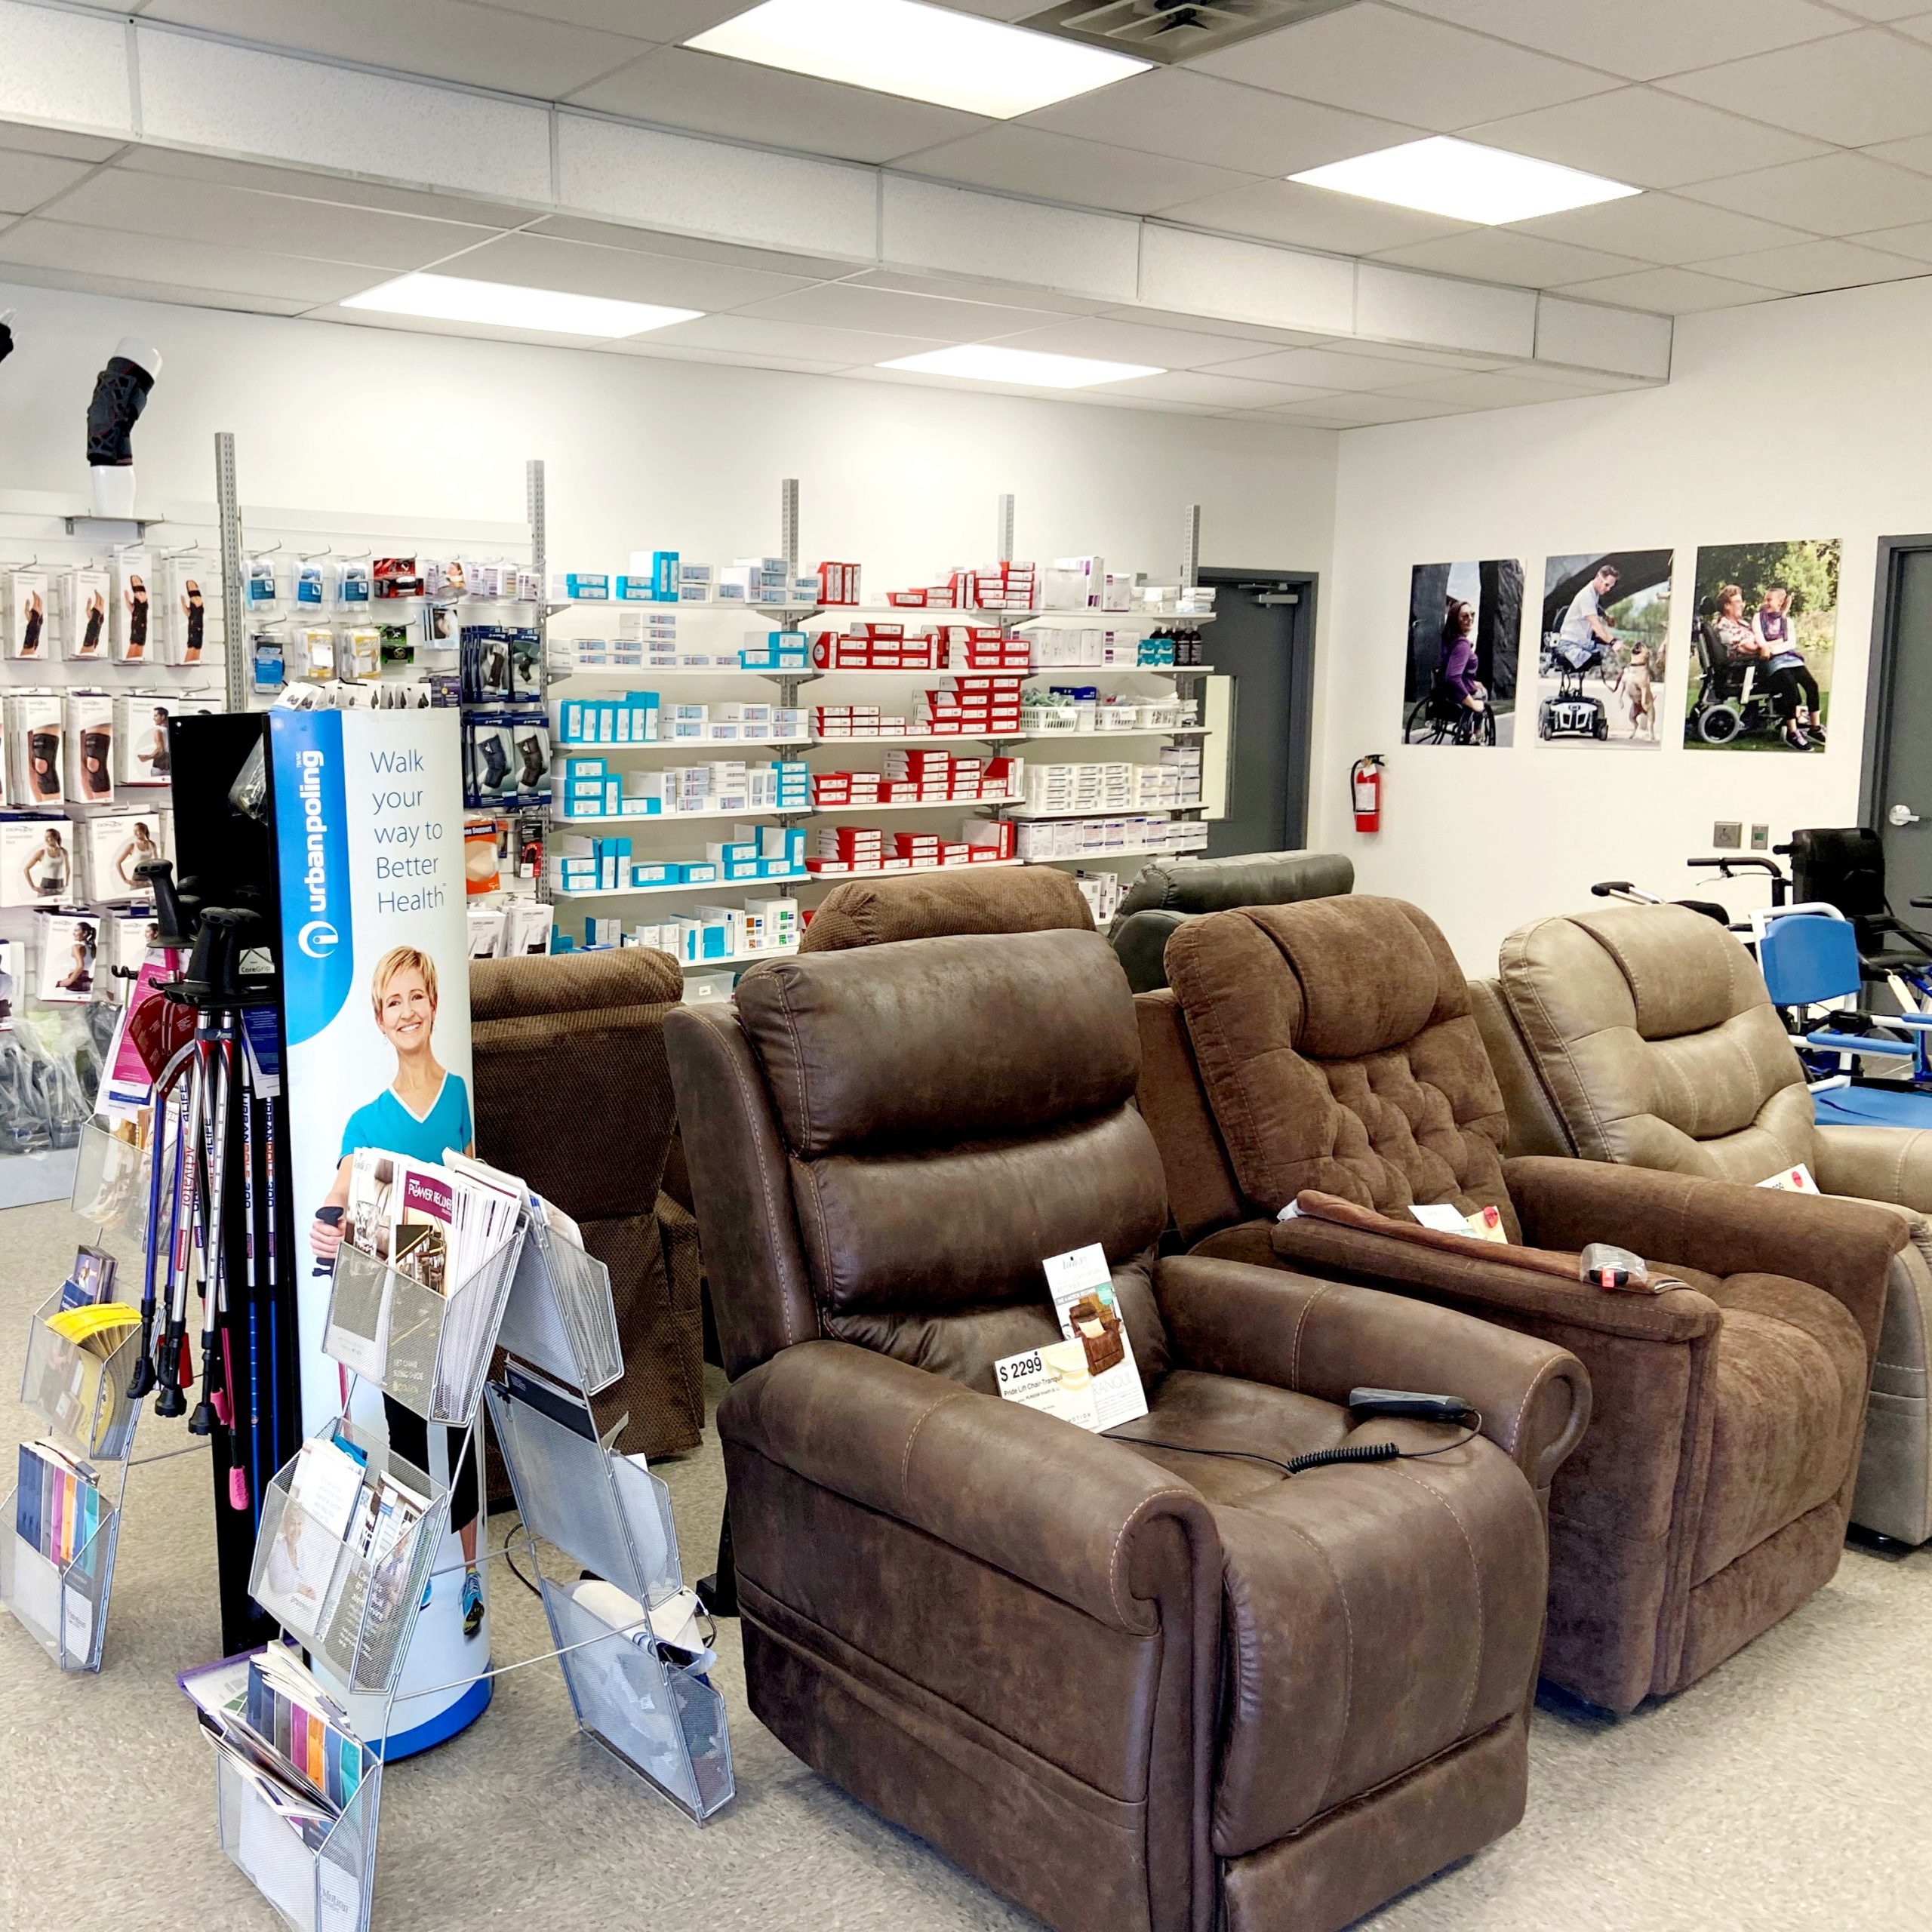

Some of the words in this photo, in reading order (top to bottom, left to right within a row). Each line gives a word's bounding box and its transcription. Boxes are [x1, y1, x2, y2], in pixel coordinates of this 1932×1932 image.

[370, 749, 425, 774] Walk
[372, 789, 424, 816] your
[300, 750, 328, 912] urbanpoling
[374, 823, 420, 849] way
[425, 821, 444, 840] to
[377, 857, 440, 880] Better
[241, 964, 271, 974] CoreGrip
[999, 1366, 1008, 1383] $
[1011, 1357, 1042, 1379] 2299
[1004, 1388, 1018, 1396] Pride
[1018, 1385, 1027, 1393] Lift
